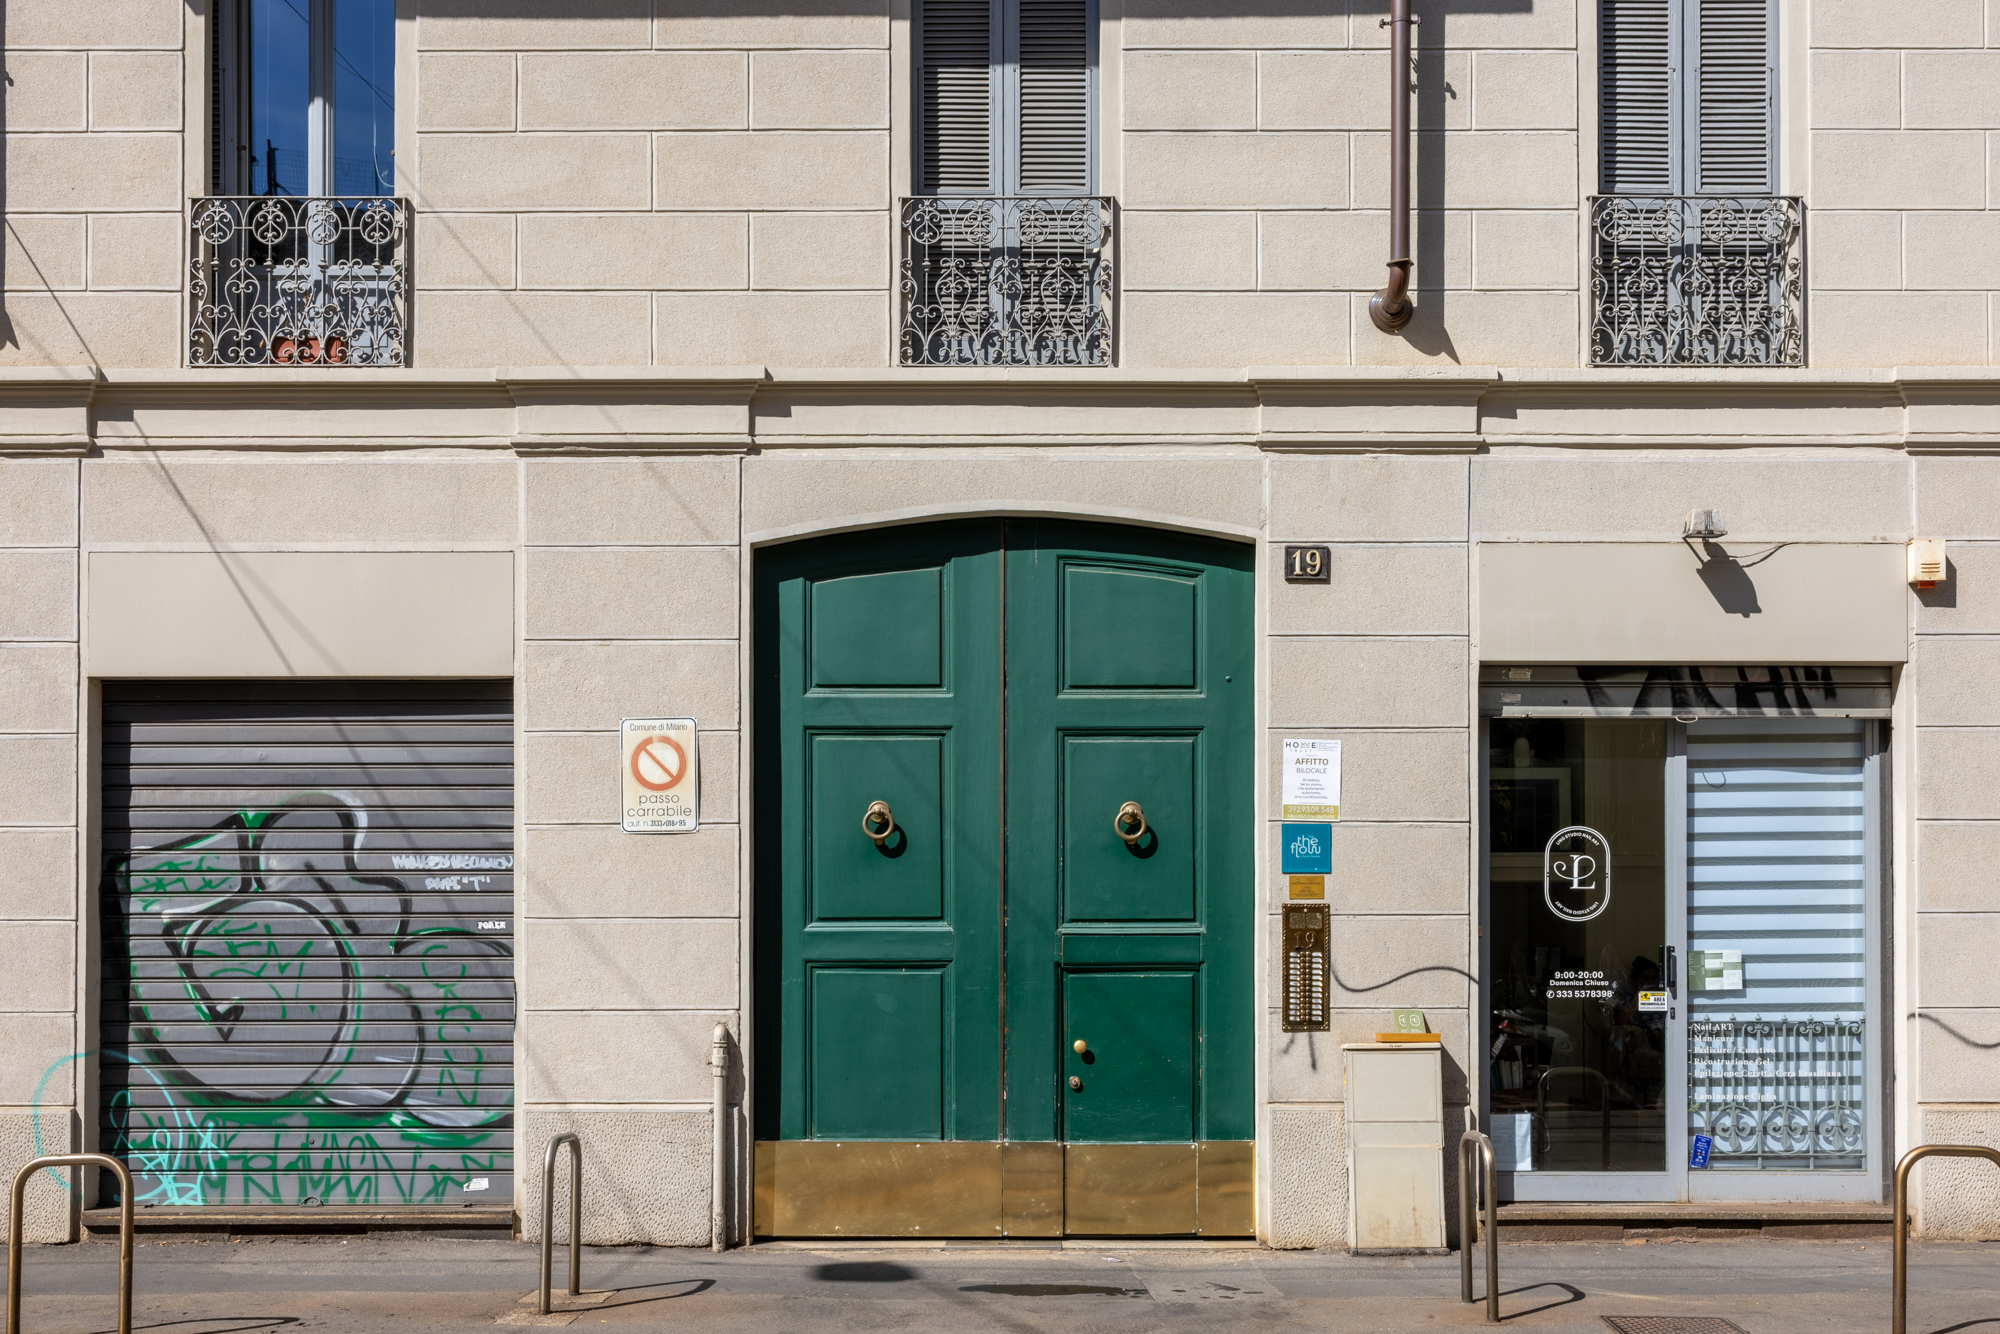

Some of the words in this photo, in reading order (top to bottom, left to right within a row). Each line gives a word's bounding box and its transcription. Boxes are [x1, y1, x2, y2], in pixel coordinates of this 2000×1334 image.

[1292, 549, 1322, 576] 19
[629, 723, 657, 732] Comune
[658, 723, 665, 731] di
[666, 722, 688, 731] Milano
[638, 794, 680, 806] passo
[627, 805, 692, 817] carrabile
[627, 820, 642, 828] aut.
[1297, 835, 1318, 846] the
[1582, 833, 1592, 841] NAIL
[1290, 842, 1321, 859] flow
[1294, 931, 1317, 949] 19
[1554, 971, 1604, 979] 9:00-20:00
[1556, 990, 1573, 998] 333
[1574, 990, 1613, 998] 5378398
[1693, 1022, 1713, 1031] Nail
[1713, 1022, 1734, 1031] ART
[1693, 1034, 1735, 1042] Manicure
[1693, 1046, 1732, 1054] Pedicure
[1738, 1046, 1776, 1054] Curativo
[1693, 1057, 1754, 1065] Ricostruzione
[1755, 1057, 1771, 1065] Gel
[1693, 1069, 1739, 1078] Epilazione
[1797, 1069, 1842, 1077] Brasiliana
[1693, 1092, 1749, 1100] Laminazione
[1750, 1092, 1777, 1102] Ciglia
